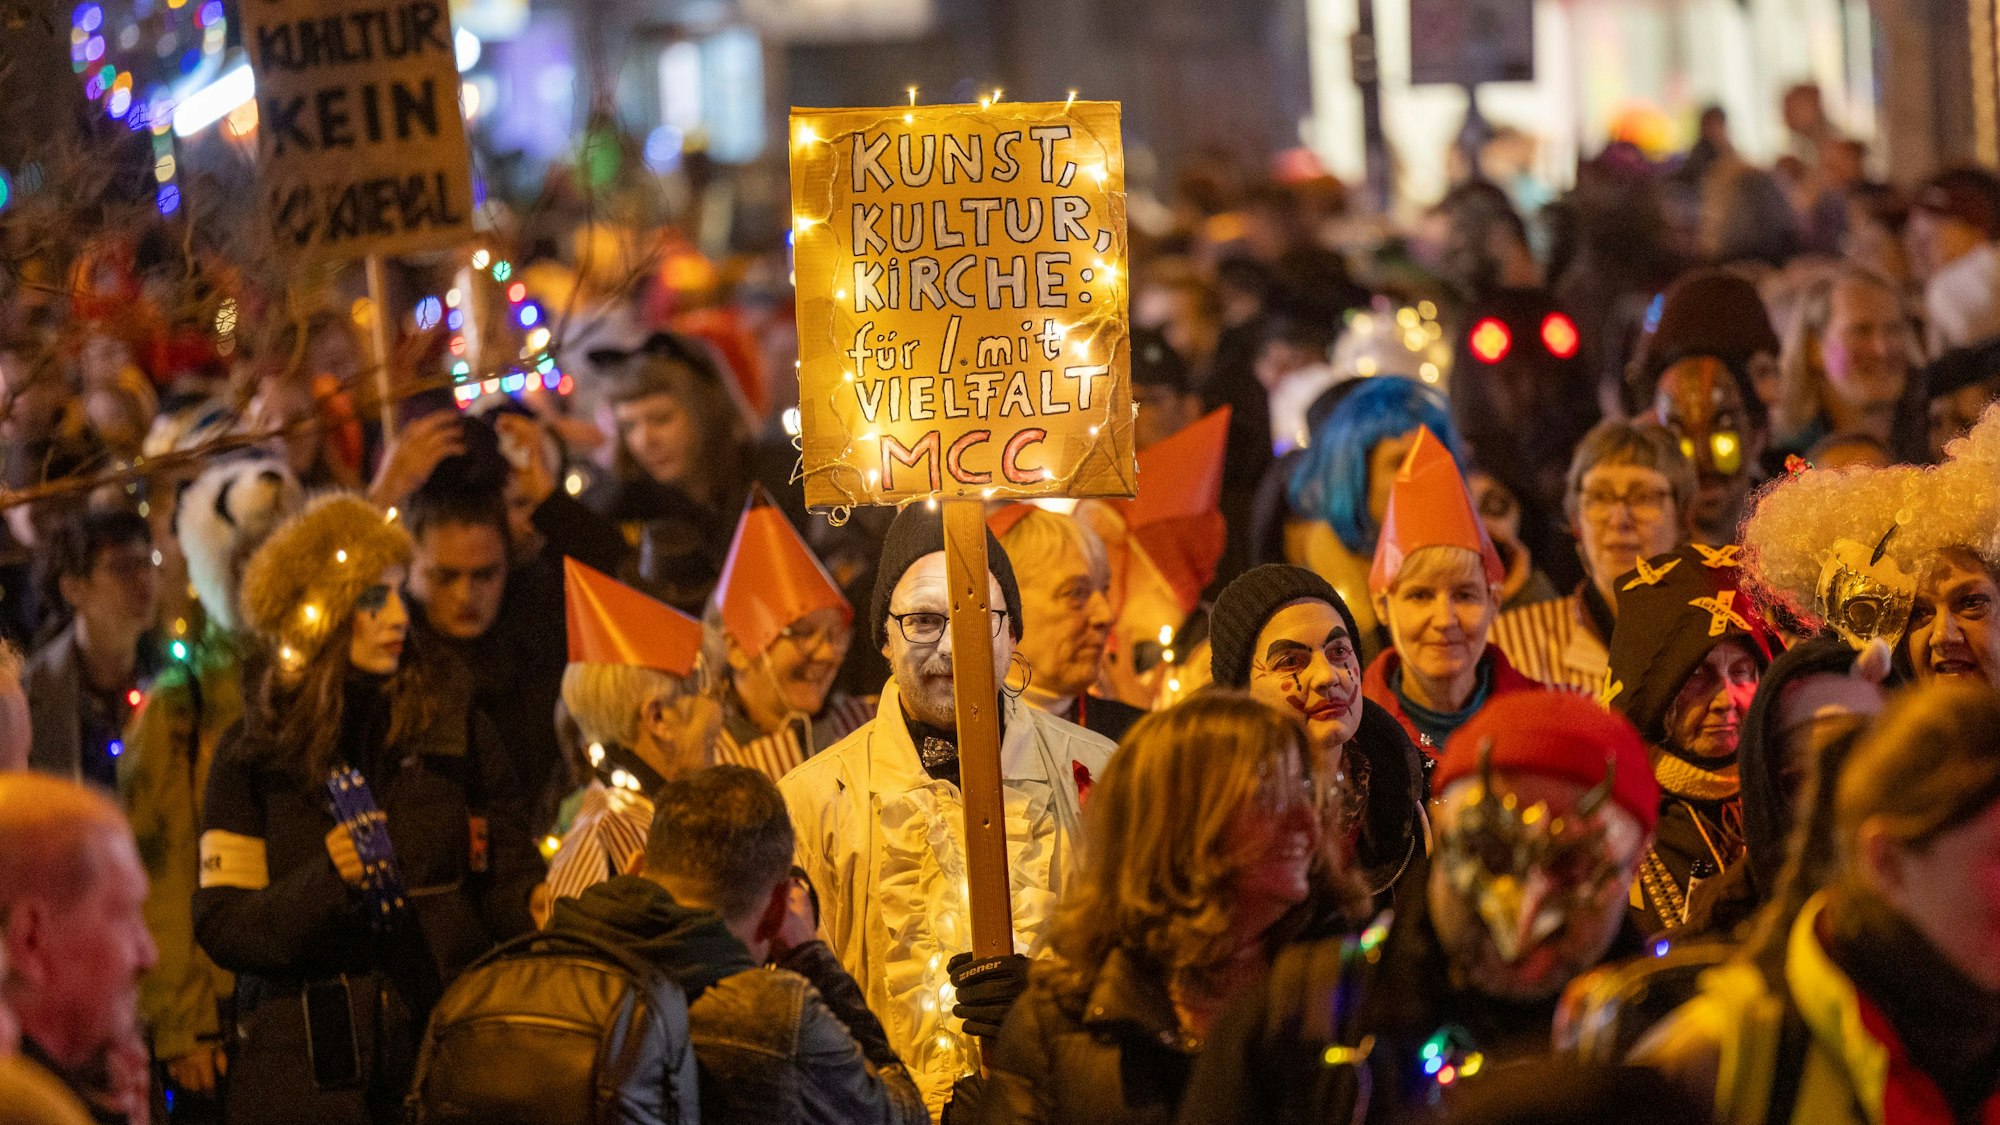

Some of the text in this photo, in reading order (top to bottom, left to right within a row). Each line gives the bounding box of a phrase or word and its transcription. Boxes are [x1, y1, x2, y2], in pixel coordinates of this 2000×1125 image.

[267, 79, 439, 153] KEIN
[851, 125, 1078, 193] KUNST,
[851, 195, 1112, 257] KULTUR,
[845, 321, 920, 378] für
[977, 318, 1063, 368] mit
[854, 364, 1109, 423] VIELFALT
[879, 427, 1048, 492] MCC
[958, 960, 1002, 982] ziener
